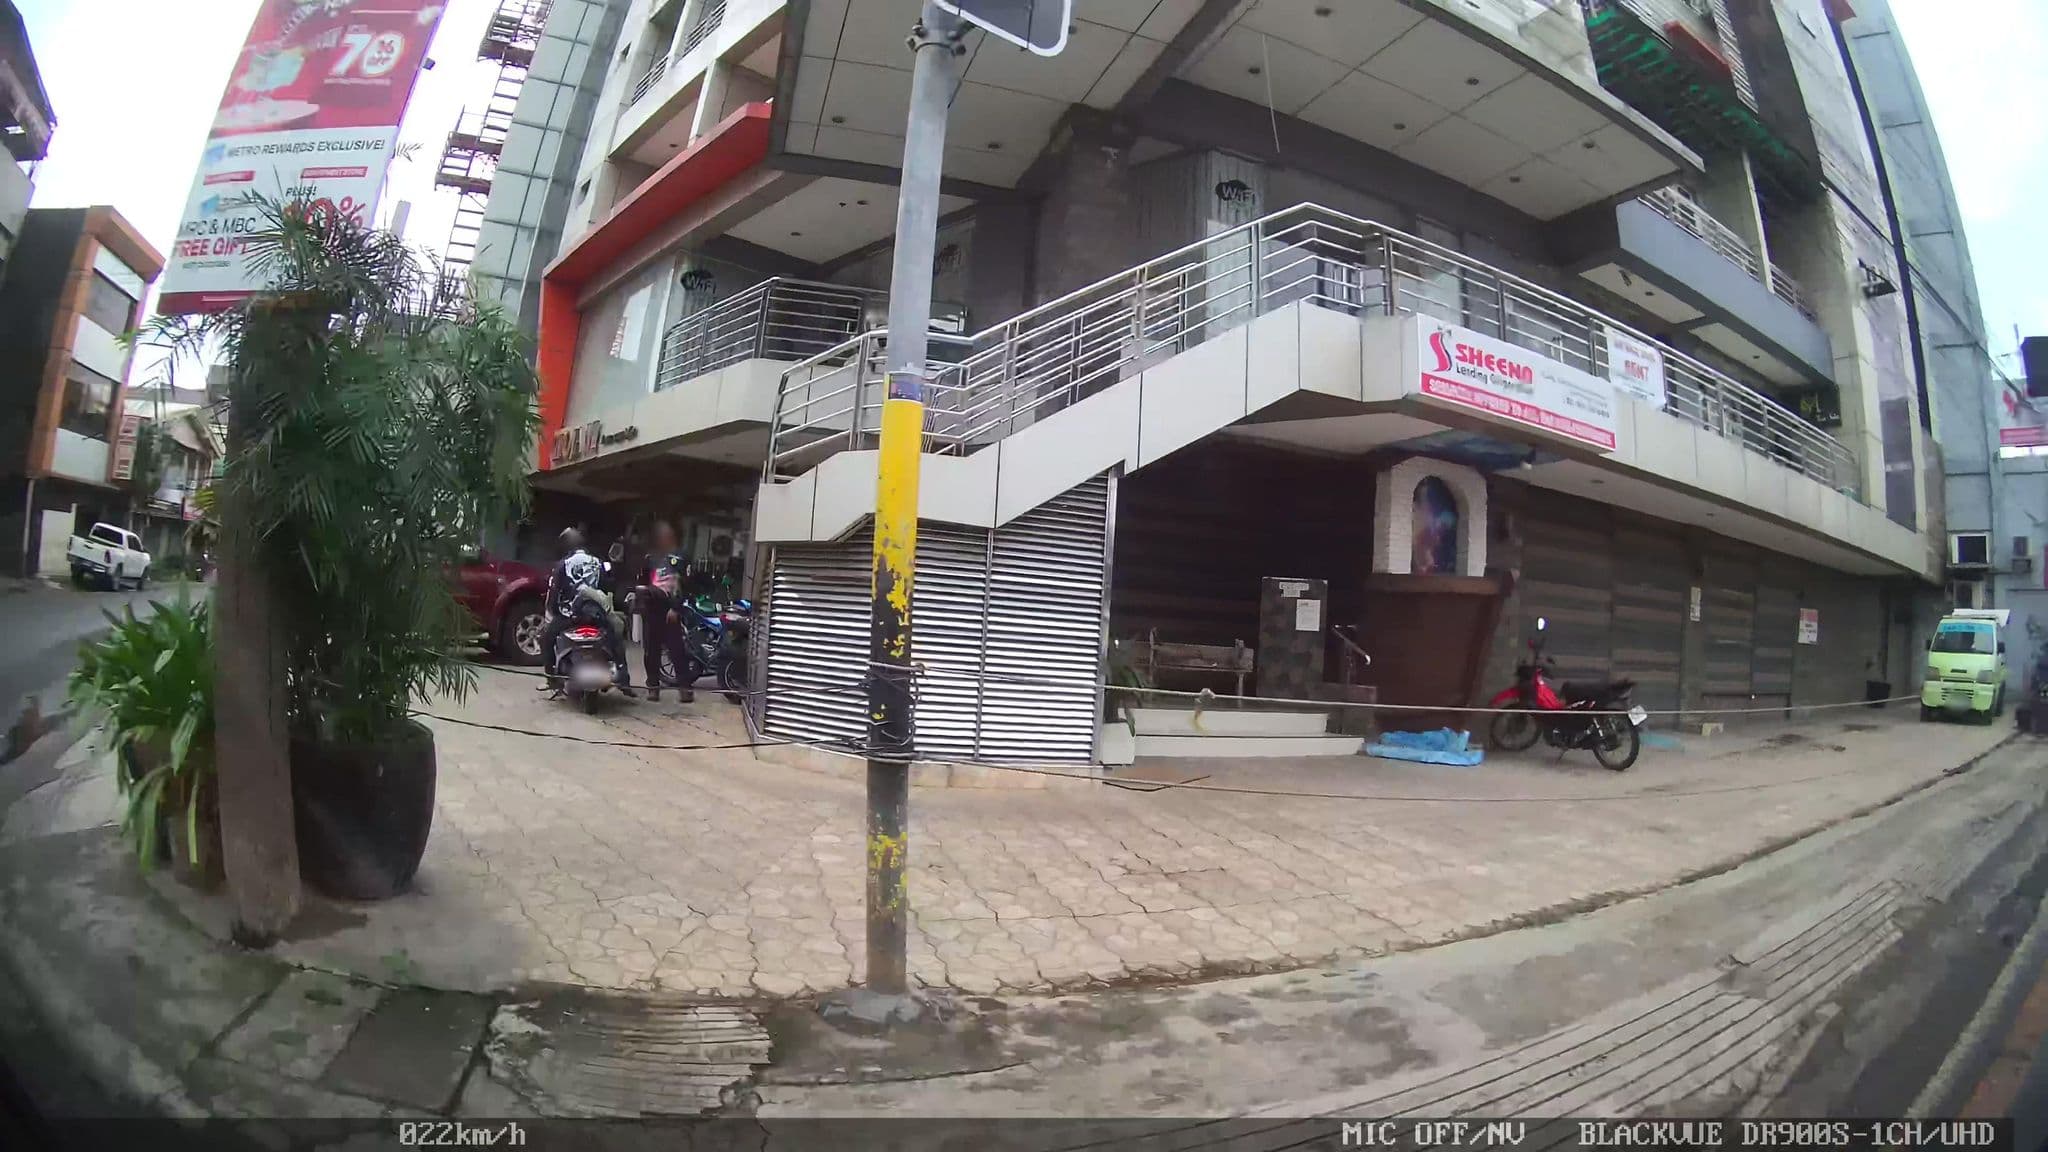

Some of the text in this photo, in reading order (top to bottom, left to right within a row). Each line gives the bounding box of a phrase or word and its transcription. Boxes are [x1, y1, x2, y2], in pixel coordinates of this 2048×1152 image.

[260, 141, 315, 155] REWARDS
[316, 138, 385, 152] EXCLUSIVE!
[222, 217, 256, 233] MBC
